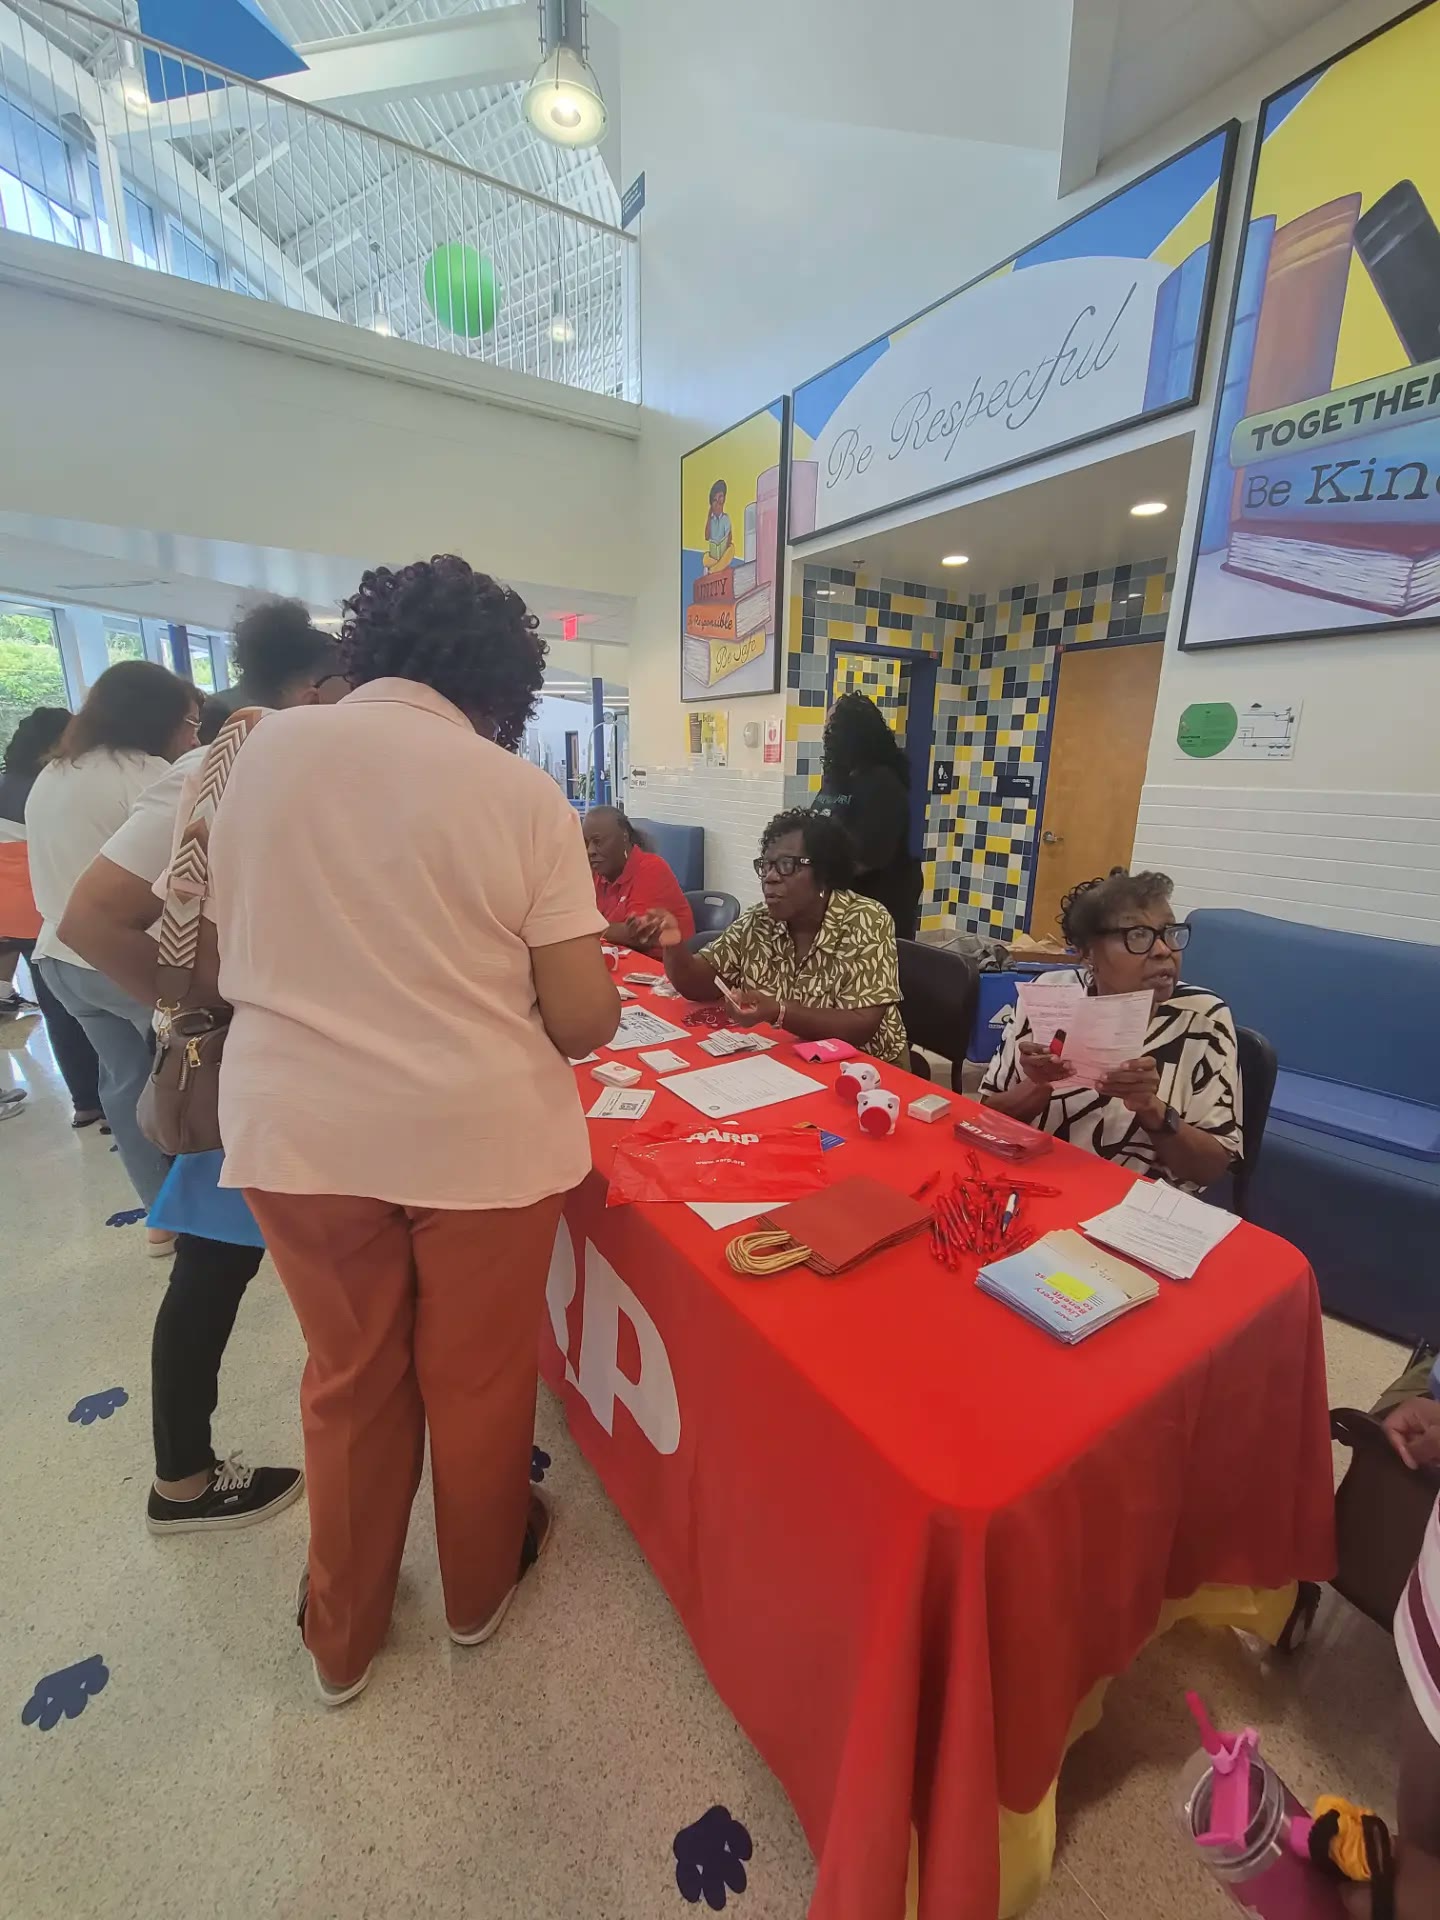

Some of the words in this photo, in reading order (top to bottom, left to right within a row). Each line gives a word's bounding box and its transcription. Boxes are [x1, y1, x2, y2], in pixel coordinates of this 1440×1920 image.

[826, 424, 875, 489] Be
[888, 281, 1138, 463] Respectful
[1244, 475, 1293, 510] Be
[1304, 456, 1440, 506] Kin
[694, 611, 733, 632] Responsible
[715, 645, 731, 673] Be
[733, 636, 757, 664] Safe
[685, 1128, 760, 1146] AARP
[1033, 1287, 1060, 1305] Every
[1052, 1290, 1087, 1314] Benefit
[1082, 1302, 1094, 1311] to
[1060, 1304, 1081, 1318] Live
